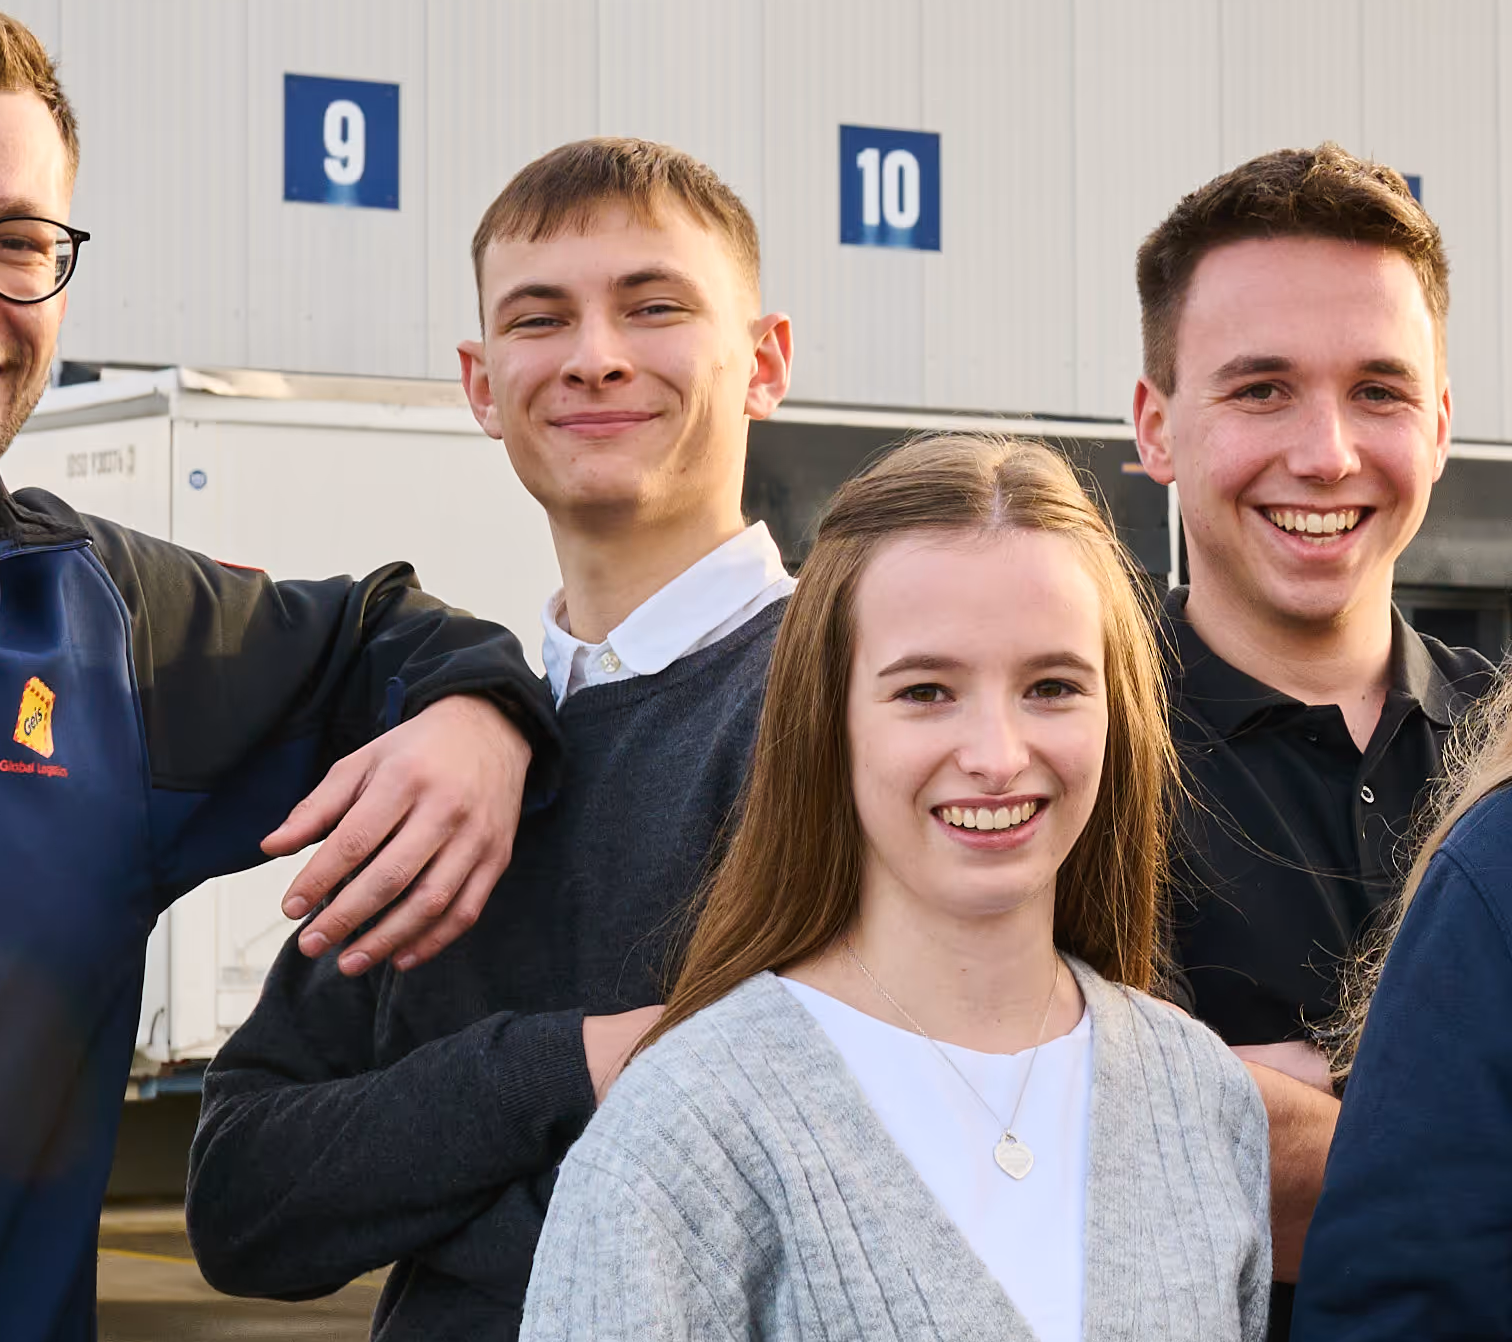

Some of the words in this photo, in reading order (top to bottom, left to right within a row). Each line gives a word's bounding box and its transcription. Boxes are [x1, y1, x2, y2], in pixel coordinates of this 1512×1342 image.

[322, 99, 366, 186] 9
[856, 147, 921, 230] 10
[24, 706, 43, 736] Geis
[0, 759, 34, 774] Global
